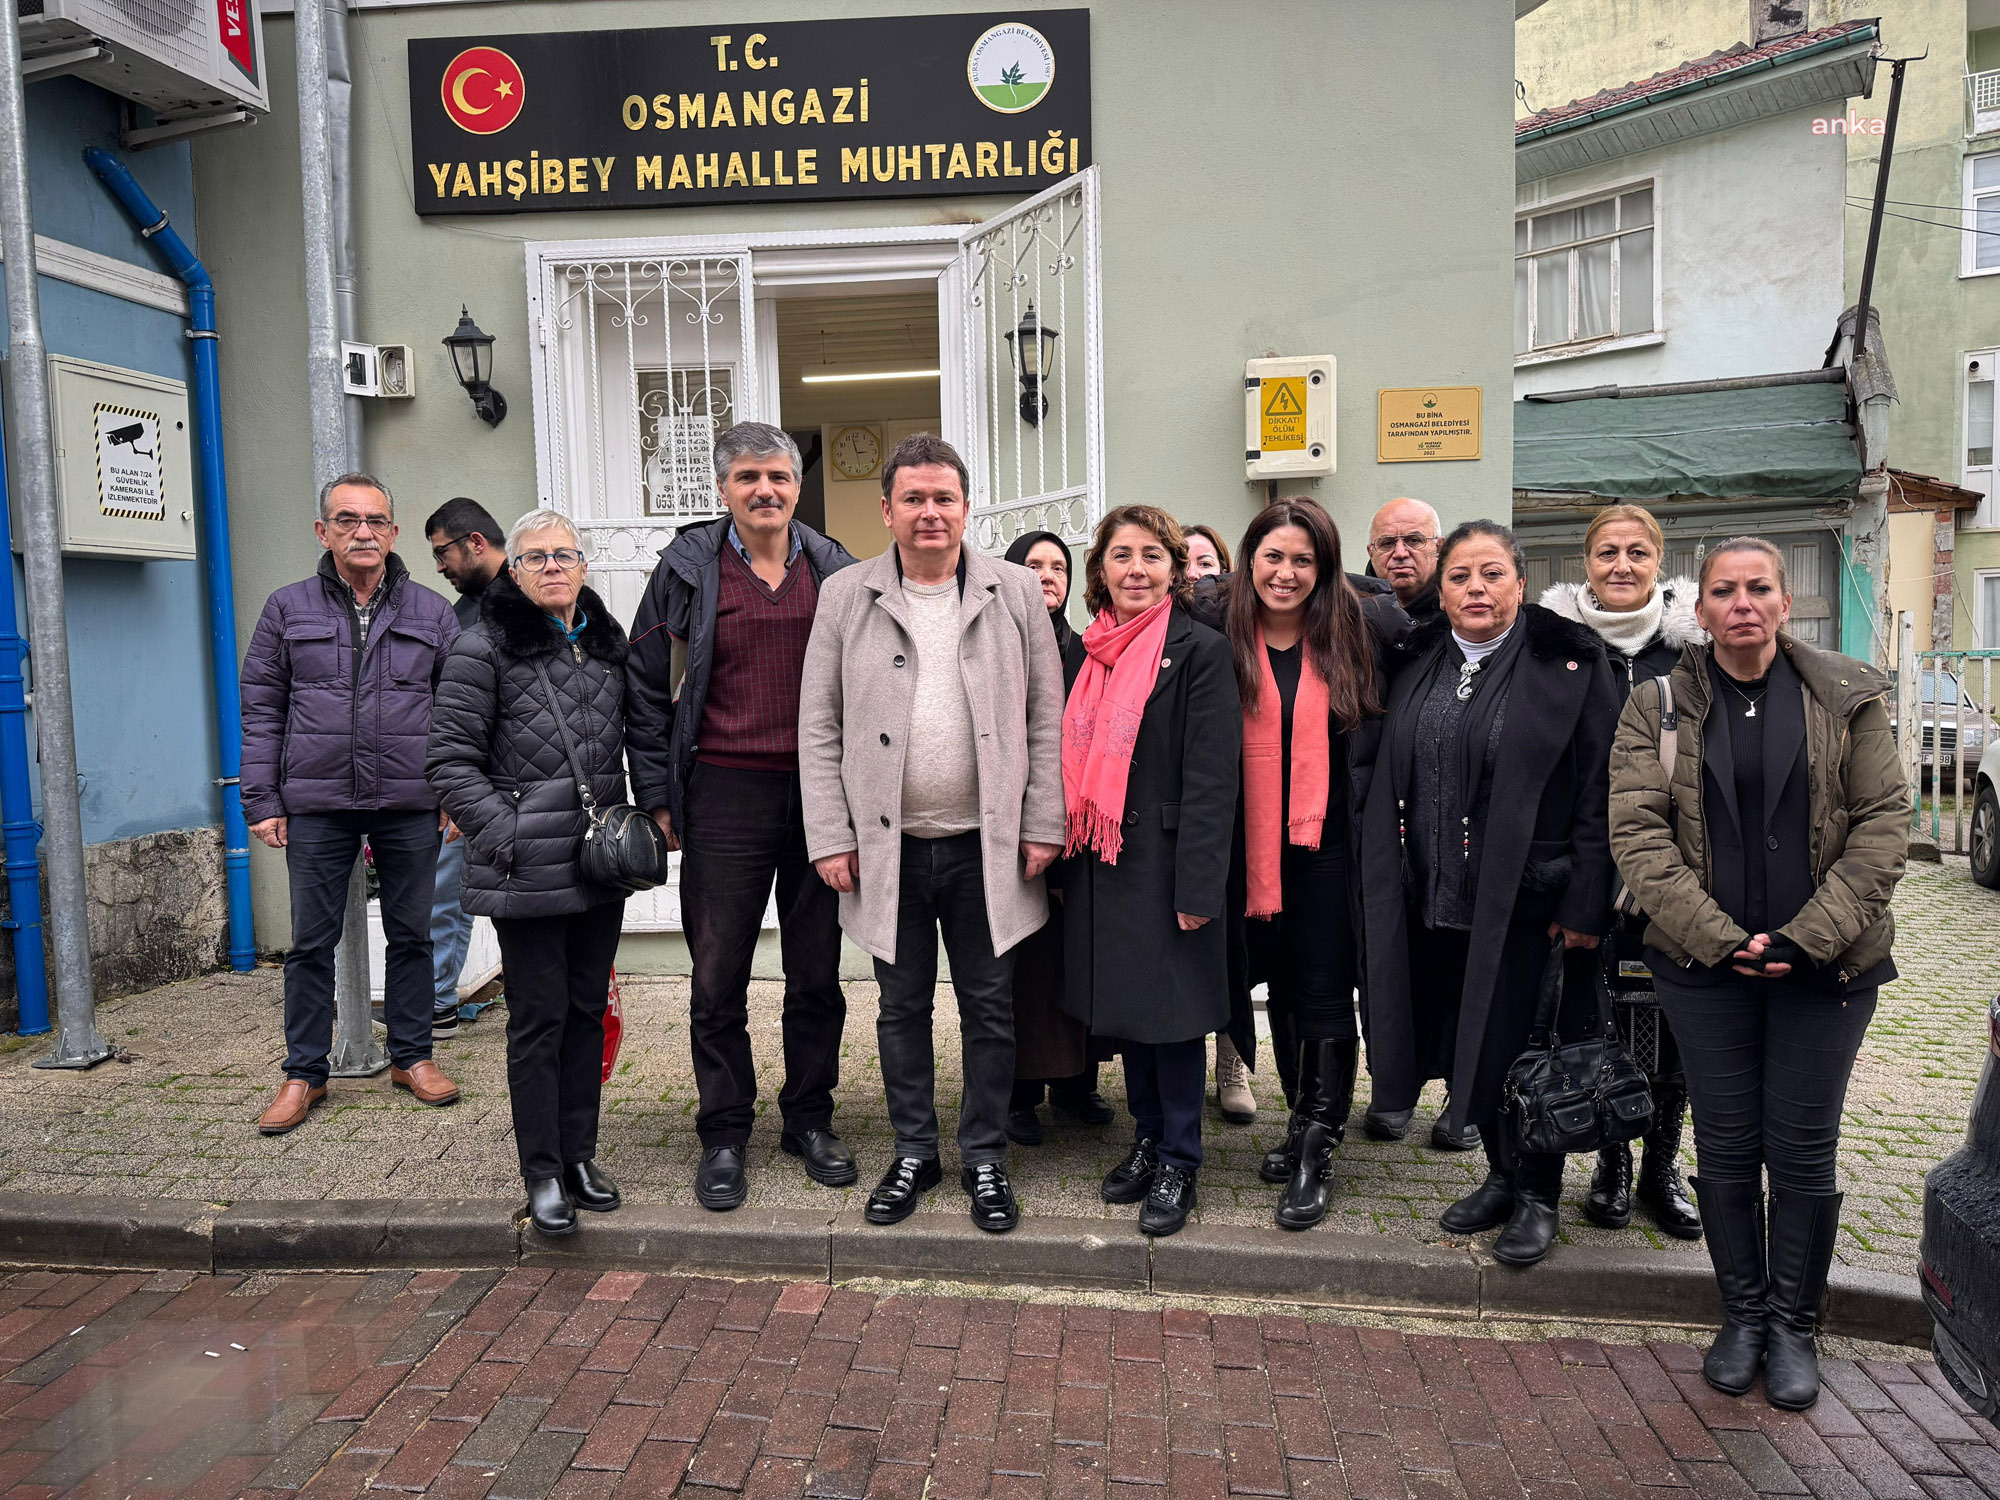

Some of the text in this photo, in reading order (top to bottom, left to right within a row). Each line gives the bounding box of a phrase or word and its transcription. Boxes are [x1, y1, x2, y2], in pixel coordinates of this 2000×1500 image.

[975, 27, 1015, 56] OSMANGAZİ
[1016, 28, 1050, 61] BELEDİYESİ
[710, 33, 778, 72] T.C.
[972, 57, 980, 82] BURSA
[622, 77, 870, 132] OSMANGAZİ
[427, 129, 1080, 203] YAHŞİBEY MAHALLE MUHTARLIĞI
[1272, 424, 1295, 433] ÖLÜM
[1390, 418, 1470, 428] OSMANGAZİ BELEDİYESİ
[1263, 432, 1304, 442] TEHLİKESİ
[1430, 428, 1472, 436] YAPILMIŞTIR.
[110, 466, 152, 478] BU ALAN 7/24
[115, 476, 149, 487] GÜVENLİK
[110, 485, 155, 496] KAMERASI İLE
[107, 492, 158, 505] İZLENMEKTEDİR
[1940, 755, 1950, 764] 98
